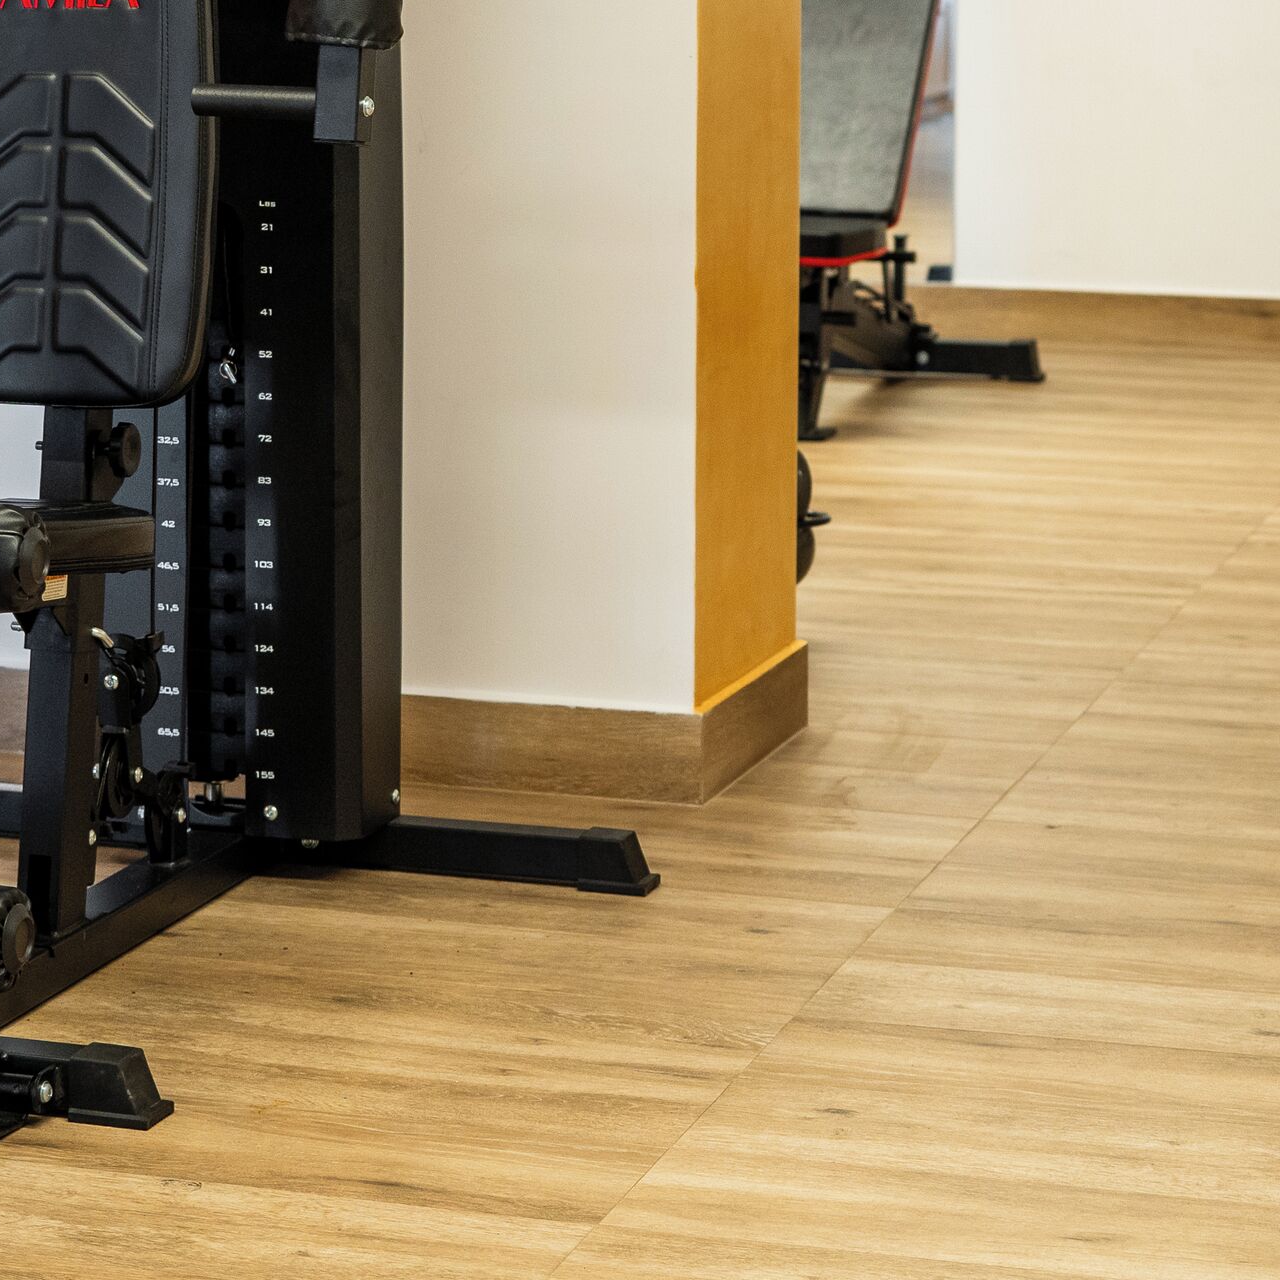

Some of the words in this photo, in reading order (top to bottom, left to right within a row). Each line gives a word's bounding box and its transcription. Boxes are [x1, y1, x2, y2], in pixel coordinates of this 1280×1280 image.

[261, 223, 273, 231] 21
[260, 266, 273, 274] 31
[260, 308, 273, 316] 41
[258, 350, 273, 359] 52
[258, 392, 273, 401] 62
[157, 435, 180, 446] 32,5
[258, 434, 273, 443] 72
[157, 477, 180, 488] 37,5
[257, 476, 272, 485] 83
[161, 520, 176, 529] 42
[257, 518, 272, 527] 93
[157, 561, 180, 572] 46,5
[254, 560, 274, 569] 103
[157, 603, 180, 613] 51,5
[254, 602, 274, 611] 114
[161, 645, 176, 654] 56
[254, 644, 274, 653] 124
[255, 686, 275, 695] 134
[157, 727, 180, 738] 65,5
[255, 728, 275, 737] 145
[255, 770, 275, 779] 155
